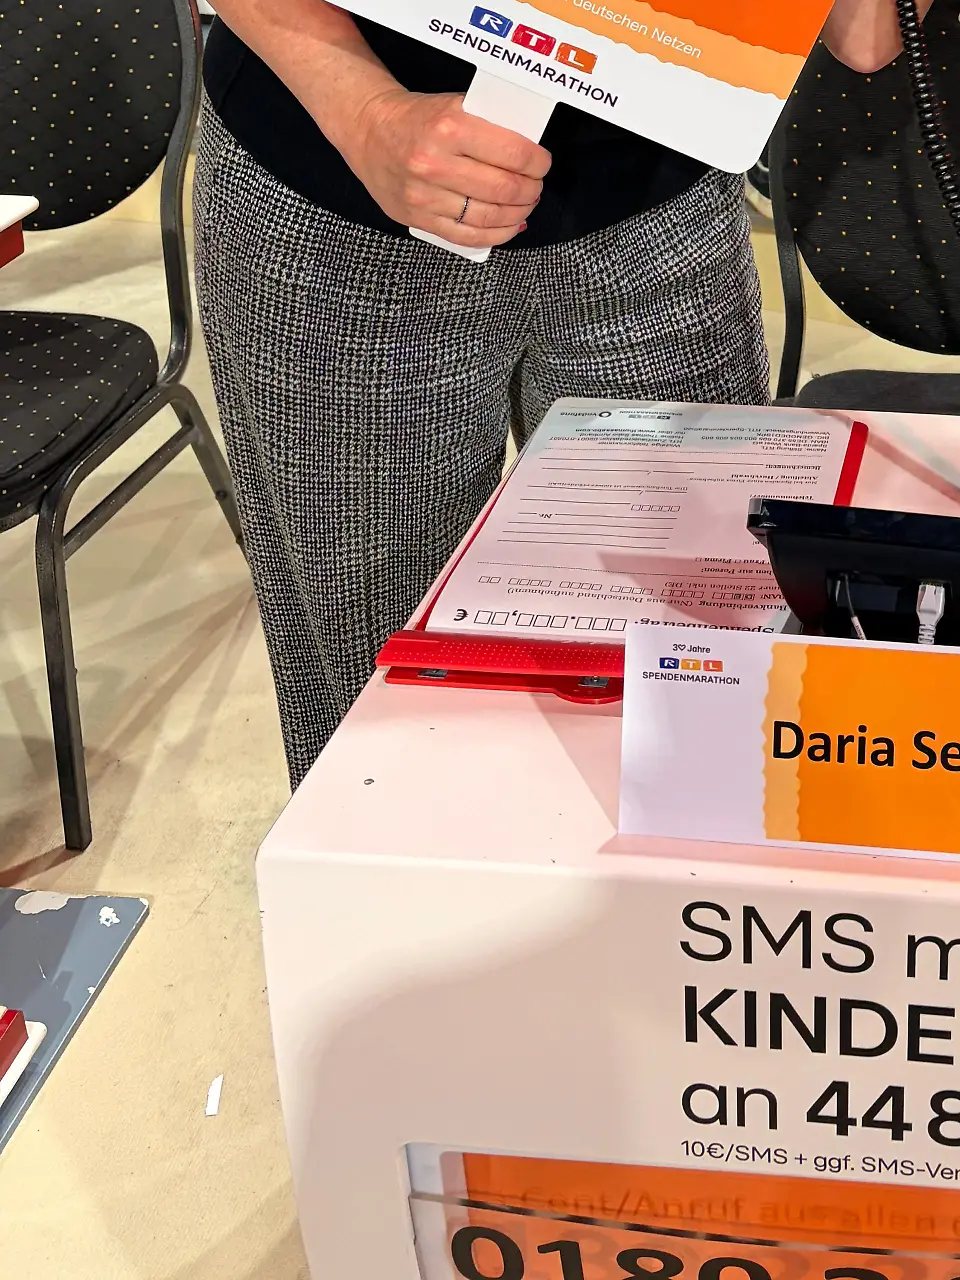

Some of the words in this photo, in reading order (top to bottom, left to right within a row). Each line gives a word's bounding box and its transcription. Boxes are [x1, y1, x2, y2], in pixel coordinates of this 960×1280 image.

[473, 8, 593, 71] RTL
[650, 27, 703, 60] Netzen
[428, 18, 619, 108] SPENDENMARATHON
[577, 592, 643, 603] Deutschland
[453, 609, 469, 621] €
[661, 658, 720, 671] RTL
[687, 644, 711, 653] Jahre
[642, 671, 740, 685] SPENDENMARATHON
[772, 720, 895, 767] Daria
[679, 900, 875, 975] SMS
[681, 1082, 779, 1131] an
[681, 1140, 788, 1166] 10€/SMS
[794, 1152, 808, 1166] +
[813, 1155, 855, 1173] ggf.
